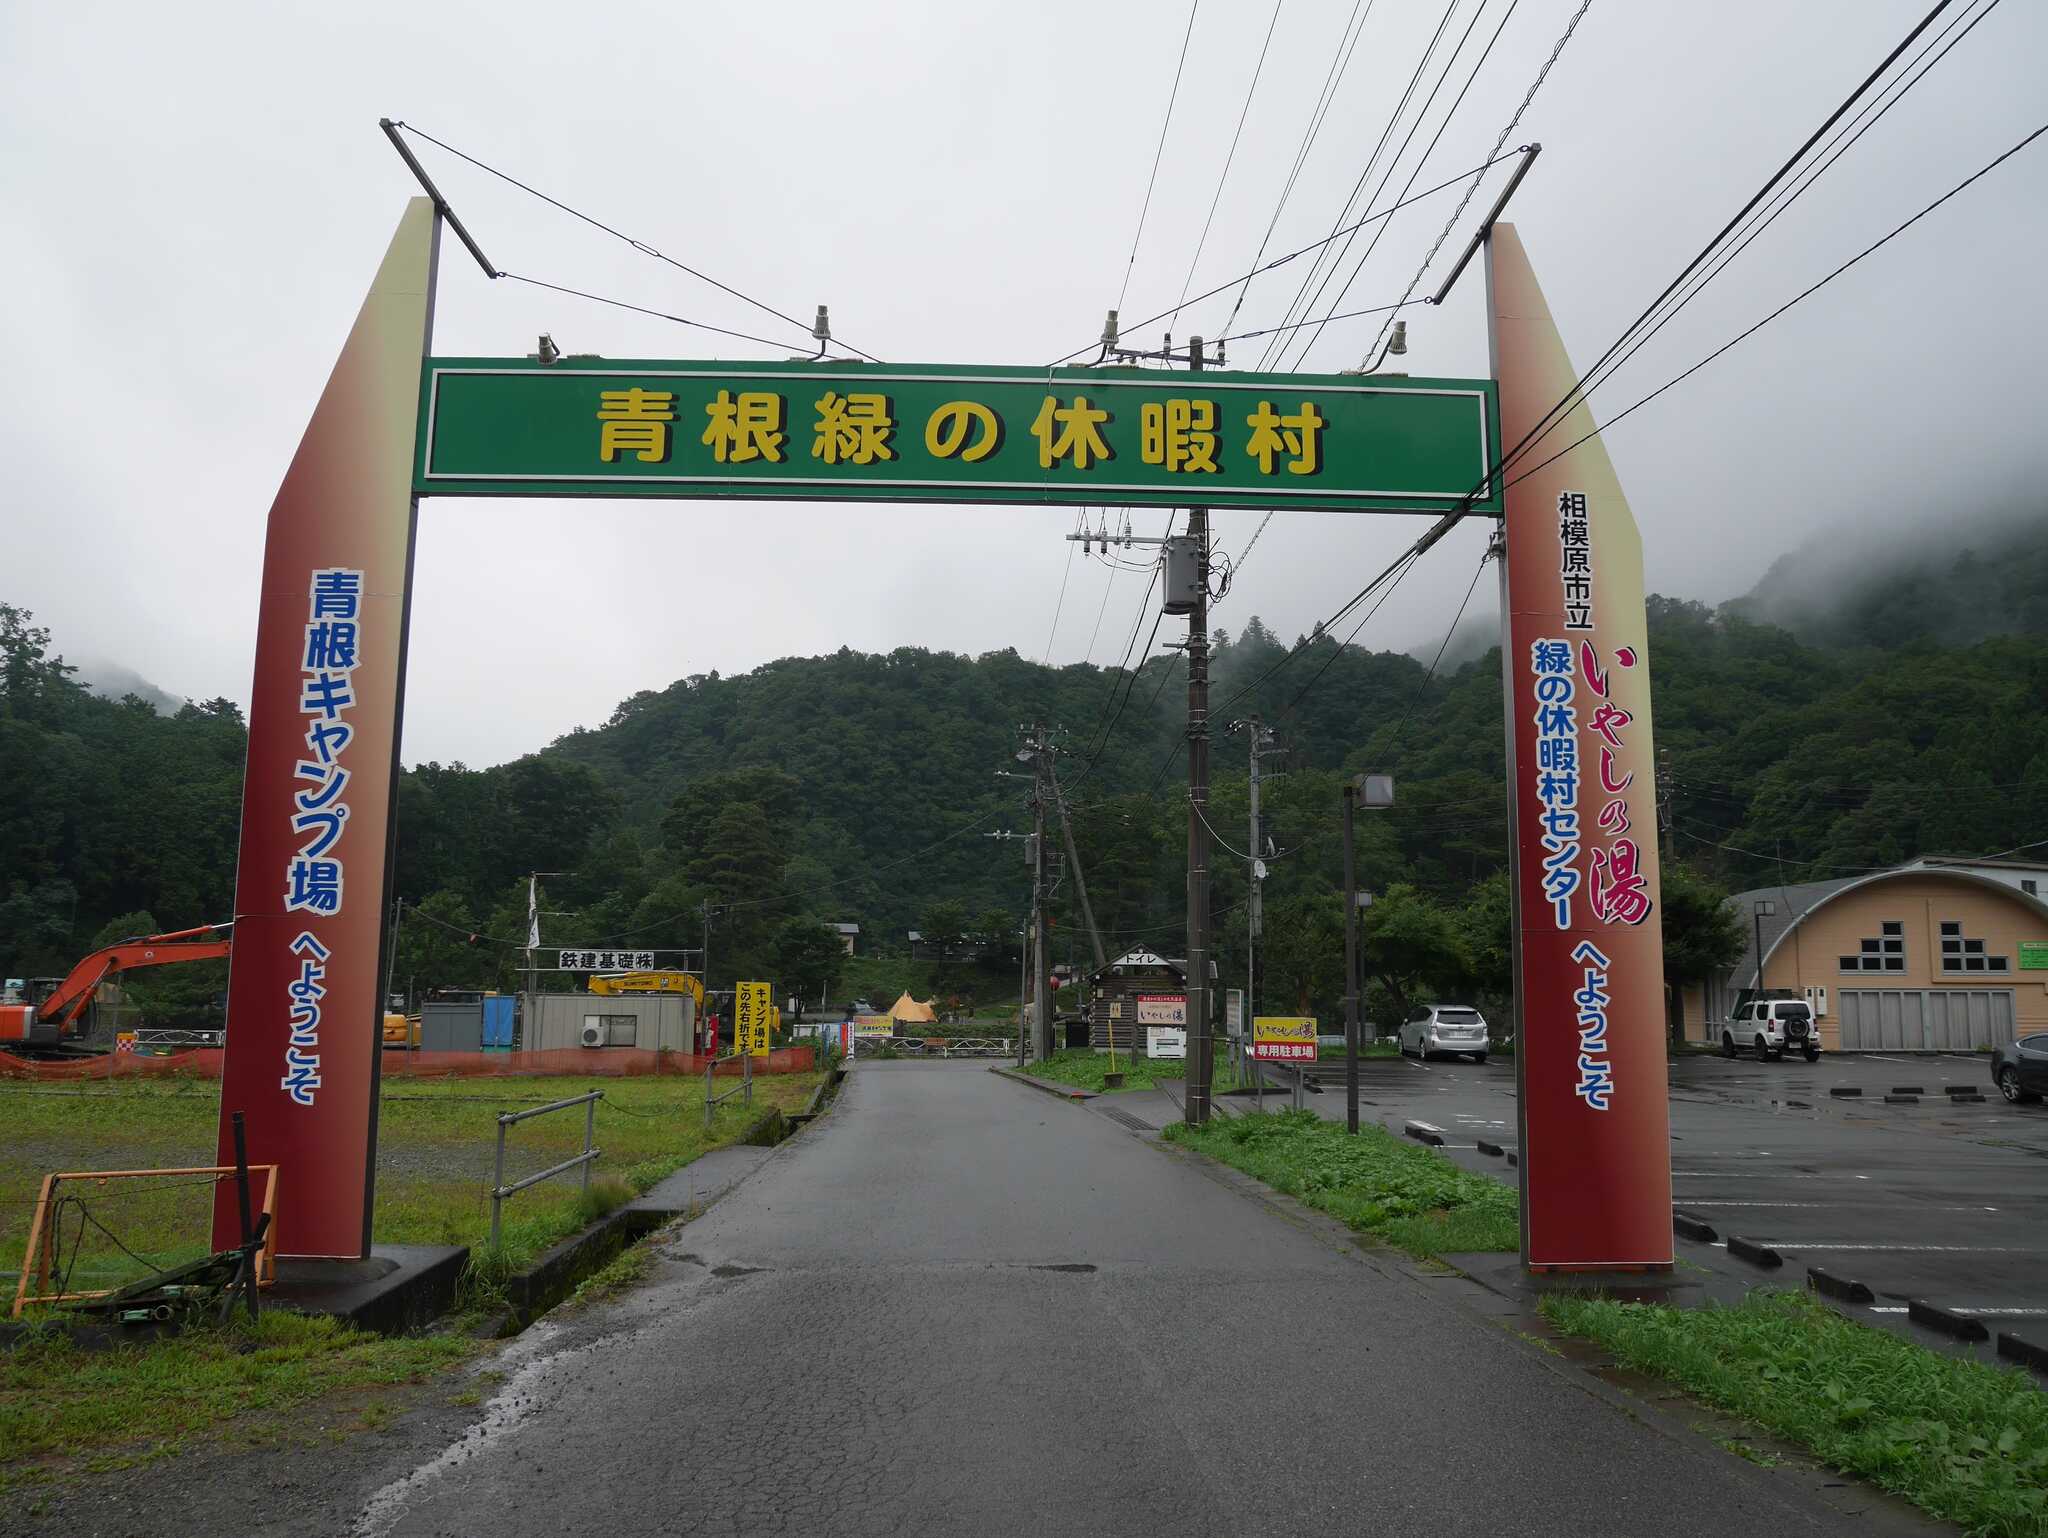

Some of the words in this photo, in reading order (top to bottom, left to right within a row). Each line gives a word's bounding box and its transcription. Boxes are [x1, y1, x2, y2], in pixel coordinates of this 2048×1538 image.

[596, 387, 1327, 476] 青根緑の休暇村
[1557, 491, 1594, 630] 相模原市立
[284, 567, 366, 917] 青根キャンプ場
[1530, 637, 1582, 930] 緑の休暇村センター
[1580, 639, 1654, 927] いやしの湯
[279, 929, 332, 1107] へようこそ
[1126, 954, 1157, 964] トイレ
[1569, 939, 1615, 1112] へようこそ
[1256, 1045, 1315, 1058] 専用駐車場
